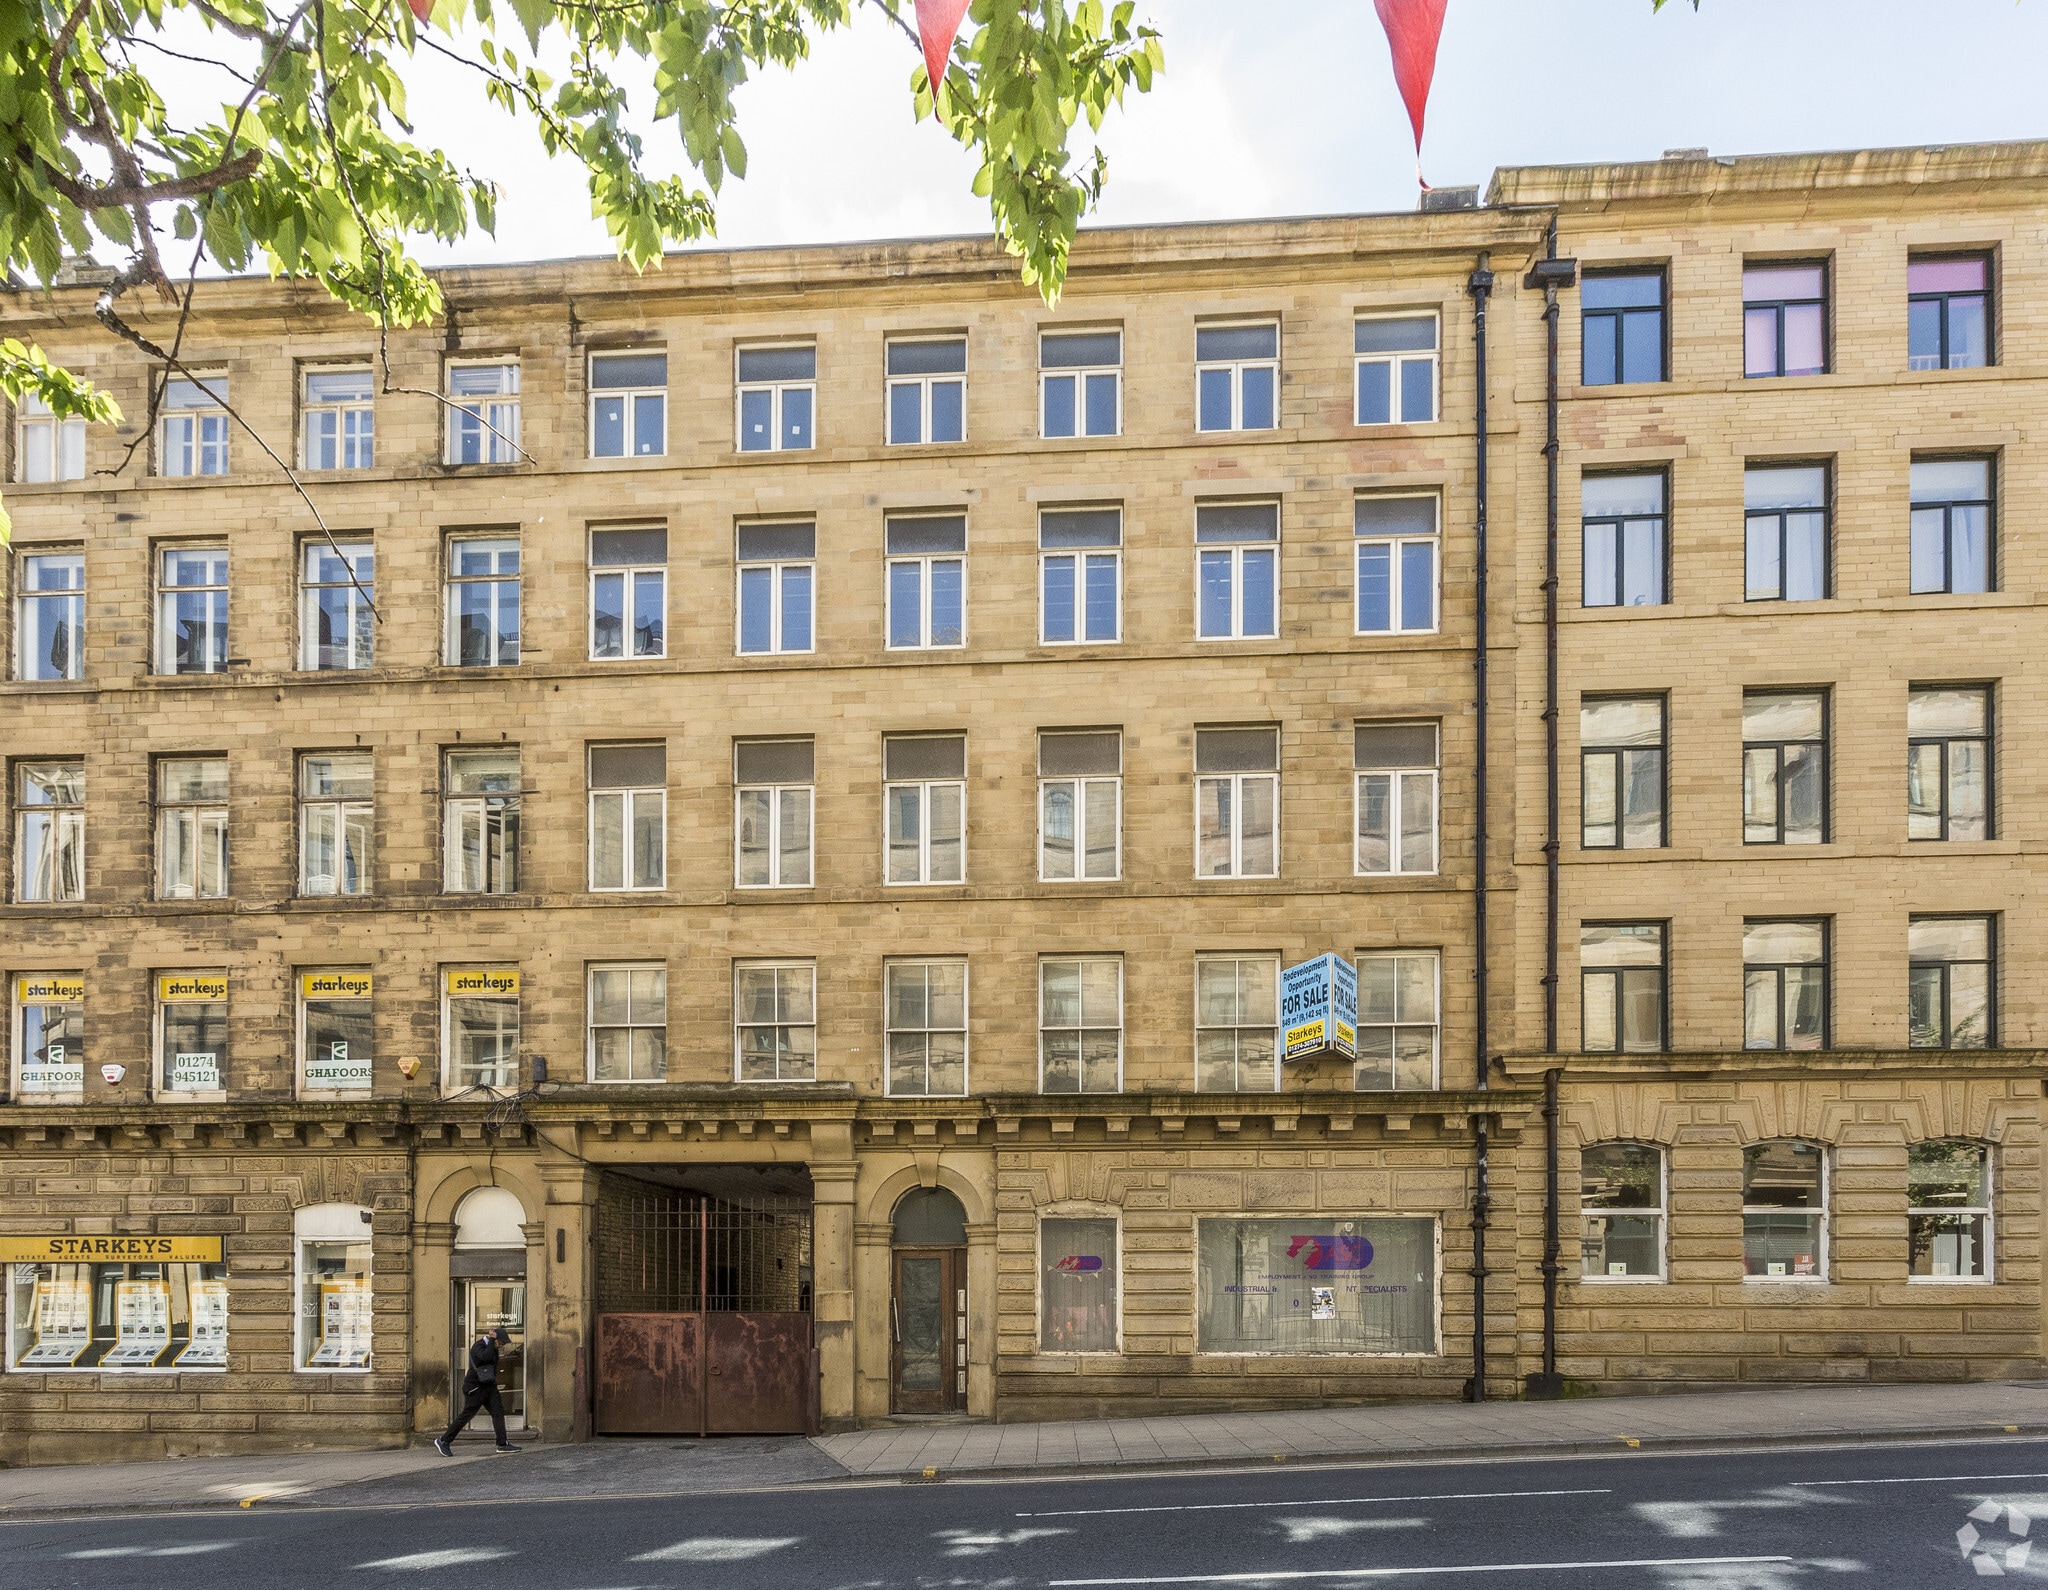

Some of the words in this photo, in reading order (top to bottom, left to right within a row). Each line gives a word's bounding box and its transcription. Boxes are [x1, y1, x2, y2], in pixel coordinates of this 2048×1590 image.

[1283, 957, 1327, 982] Redevelopment
[27, 981, 83, 999] starkeys
[168, 979, 225, 998] starkeys
[311, 976, 369, 995] starkeys
[456, 974, 514, 992] starkeys
[1287, 973, 1322, 993] Opportunity
[1282, 994, 1300, 1016] FOR
[1303, 983, 1328, 1009] SALE
[1334, 983, 1344, 1007] FOR
[1345, 990, 1356, 1015] SALE
[1287, 1023, 1322, 1042] Starkeys
[178, 1056, 214, 1067] 01274
[21, 1071, 83, 1081] GHAFOOR
[174, 1071, 216, 1082] 945121
[49, 1239, 172, 1253] STARKEYS
[1224, 1285, 1270, 1293] INDUSTRIAL
[1271, 1285, 1277, 1293] &
